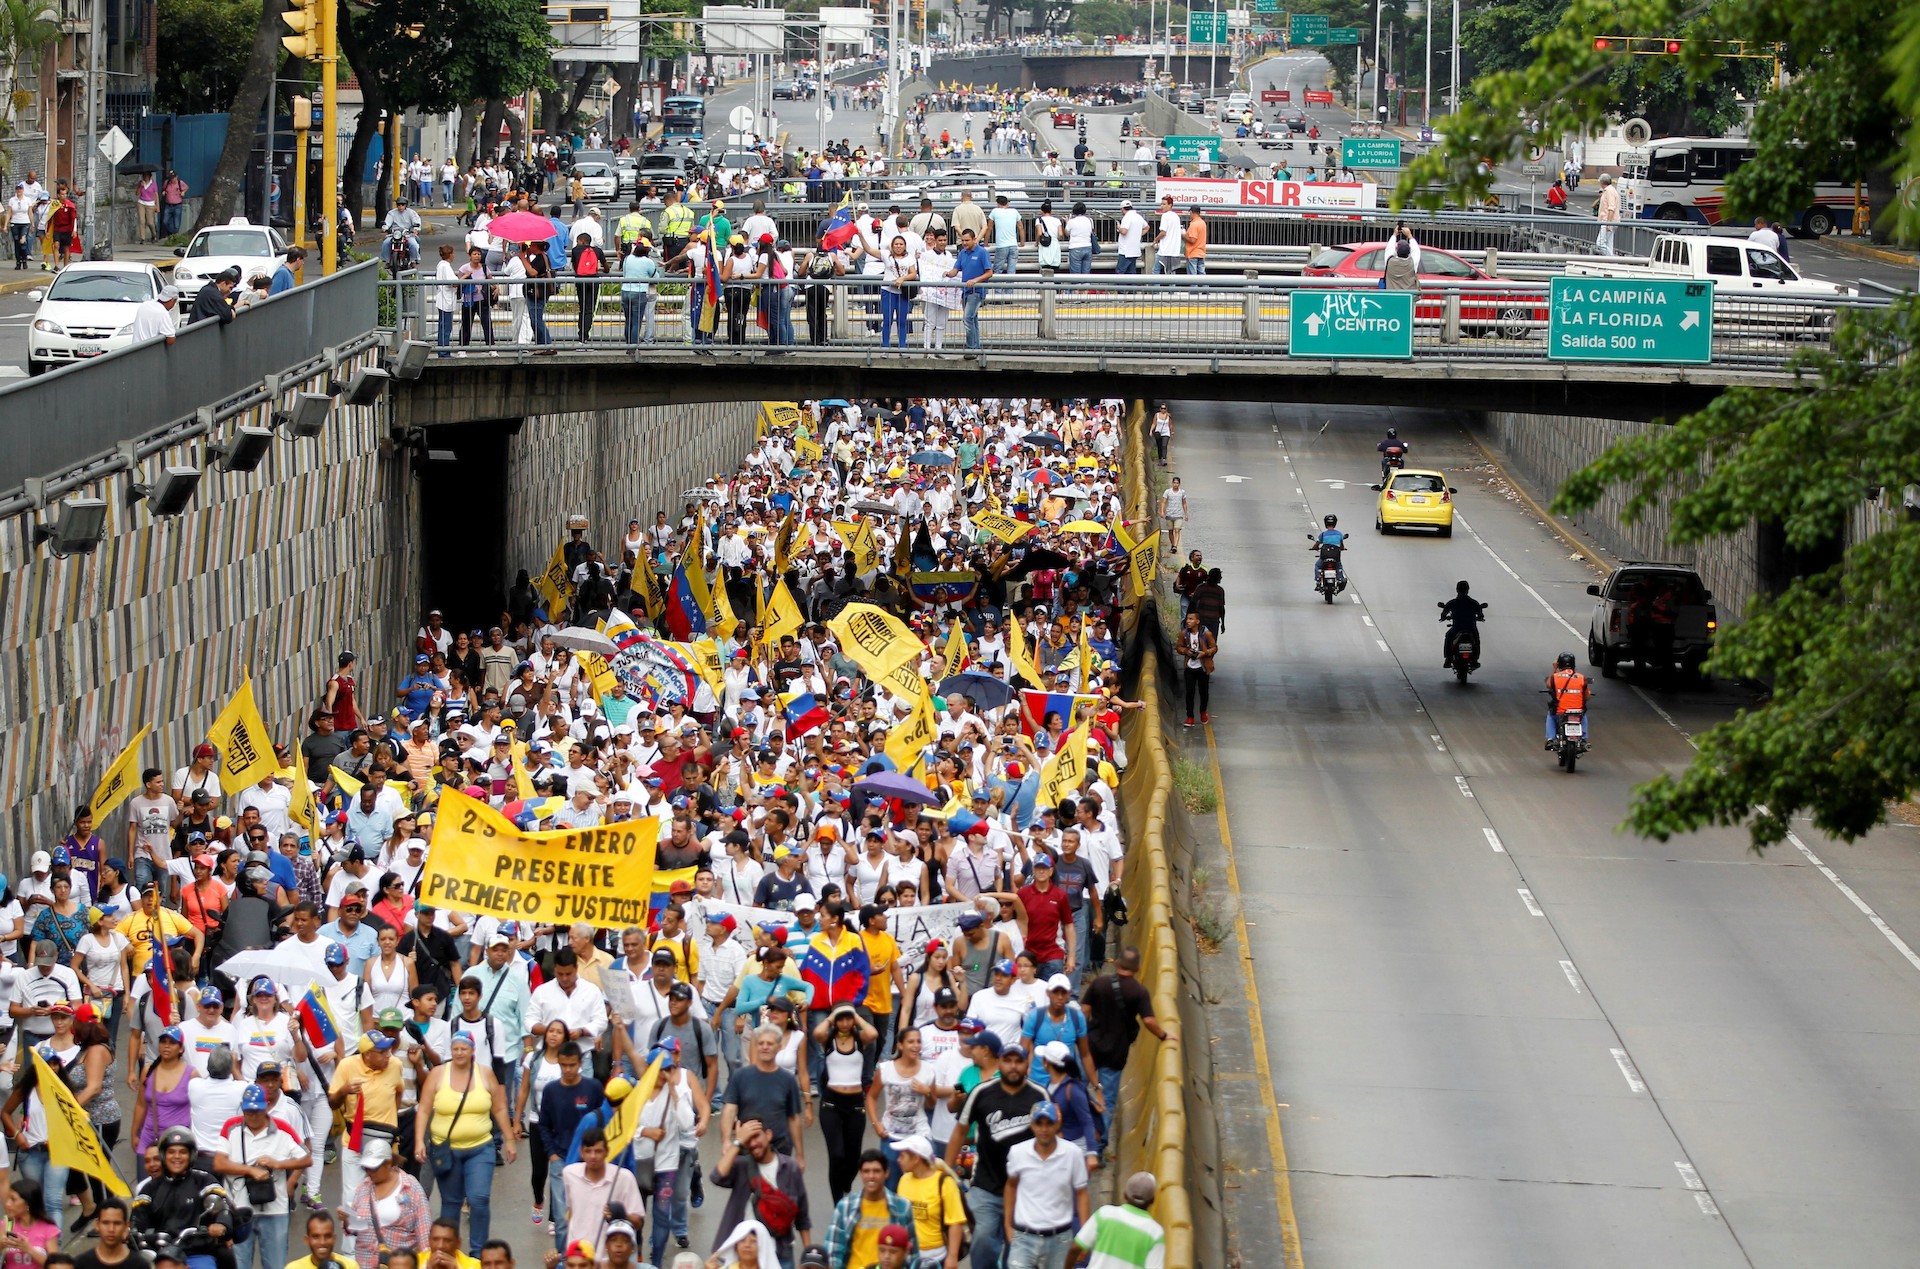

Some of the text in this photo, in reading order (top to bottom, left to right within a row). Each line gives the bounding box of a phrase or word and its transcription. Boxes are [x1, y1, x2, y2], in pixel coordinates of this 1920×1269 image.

[1202, 195, 1224, 204] Paga
[1241, 181, 1301, 206] ISLR
[1563, 288, 1667, 305] LA CAMPIÑA
[1334, 318, 1401, 332] CENTRO
[1561, 312, 1664, 327] LA FLORIDA
[1561, 334, 1656, 349] Salida 500 m
[565, 829, 637, 855] ENERO
[495, 855, 616, 888] PRESENTE
[428, 873, 542, 915] PRIMERO
[985, 1109, 1032, 1130] Caraca
